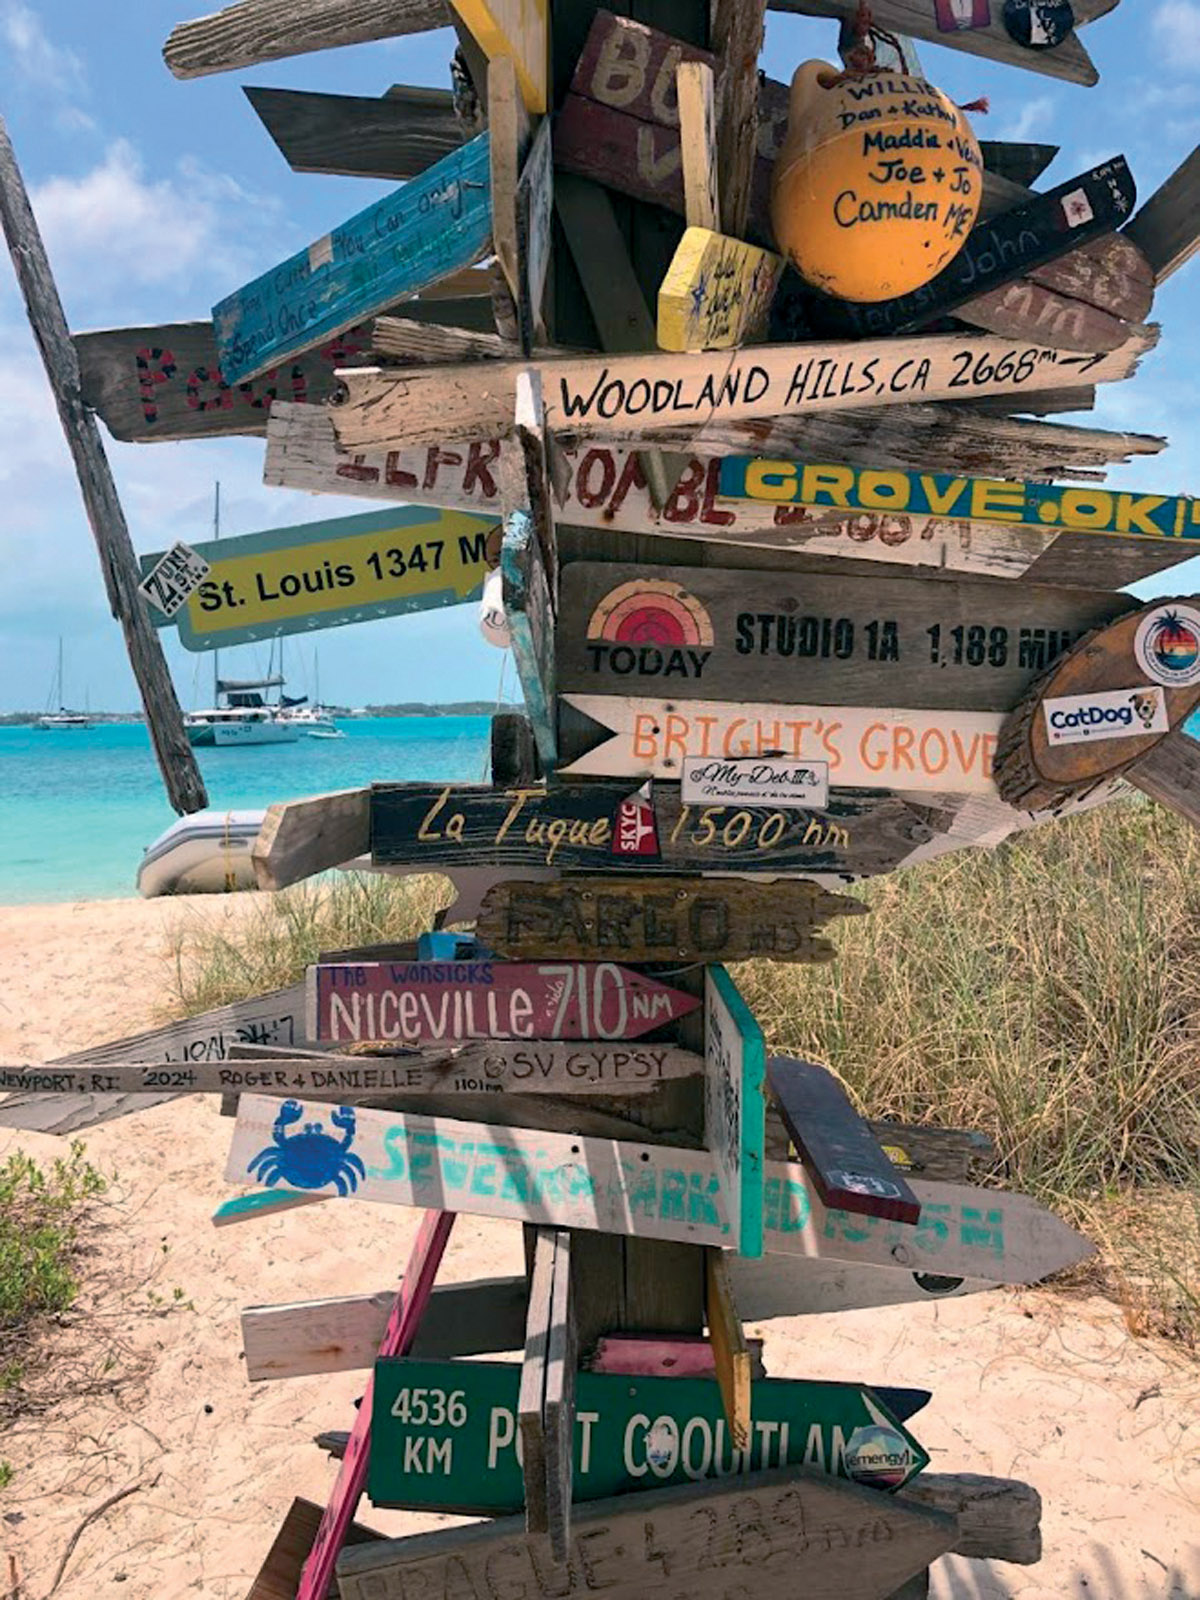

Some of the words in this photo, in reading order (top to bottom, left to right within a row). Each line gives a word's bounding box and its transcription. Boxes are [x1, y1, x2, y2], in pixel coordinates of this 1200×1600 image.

[836, 107, 881, 129] Dan
[867, 159, 926, 184] Joe
[949, 167, 972, 195] Jo
[833, 190, 938, 228] Camden
[961, 229, 1039, 282] John
[560, 368, 769, 418] WOODLAND
[198, 580, 246, 612] St.
[256, 561, 355, 601] Louis
[366, 541, 445, 581] 1347
[736, 612, 854, 659] STUDIO
[864, 620, 899, 662] 1A
[926, 623, 1008, 668] 1,188
[586, 645, 712, 678] TODAY
[1050, 706, 1132, 730] CatDog
[633, 713, 843, 770] BRIGHT'S
[417, 787, 465, 842] La
[495, 789, 610, 866] Tuque
[670, 804, 786, 849] 1500
[802, 818, 850, 849] nm
[538, 963, 628, 1039] 710
[633, 992, 673, 1020] NM
[219, 1069, 288, 1088] ROGER
[311, 1068, 422, 1089] DANIELLE
[512, 1052, 554, 1079] SV
[566, 1052, 668, 1079] GYPSY
[391, 1388, 468, 1428] 4536
[403, 1436, 453, 1475] KM
